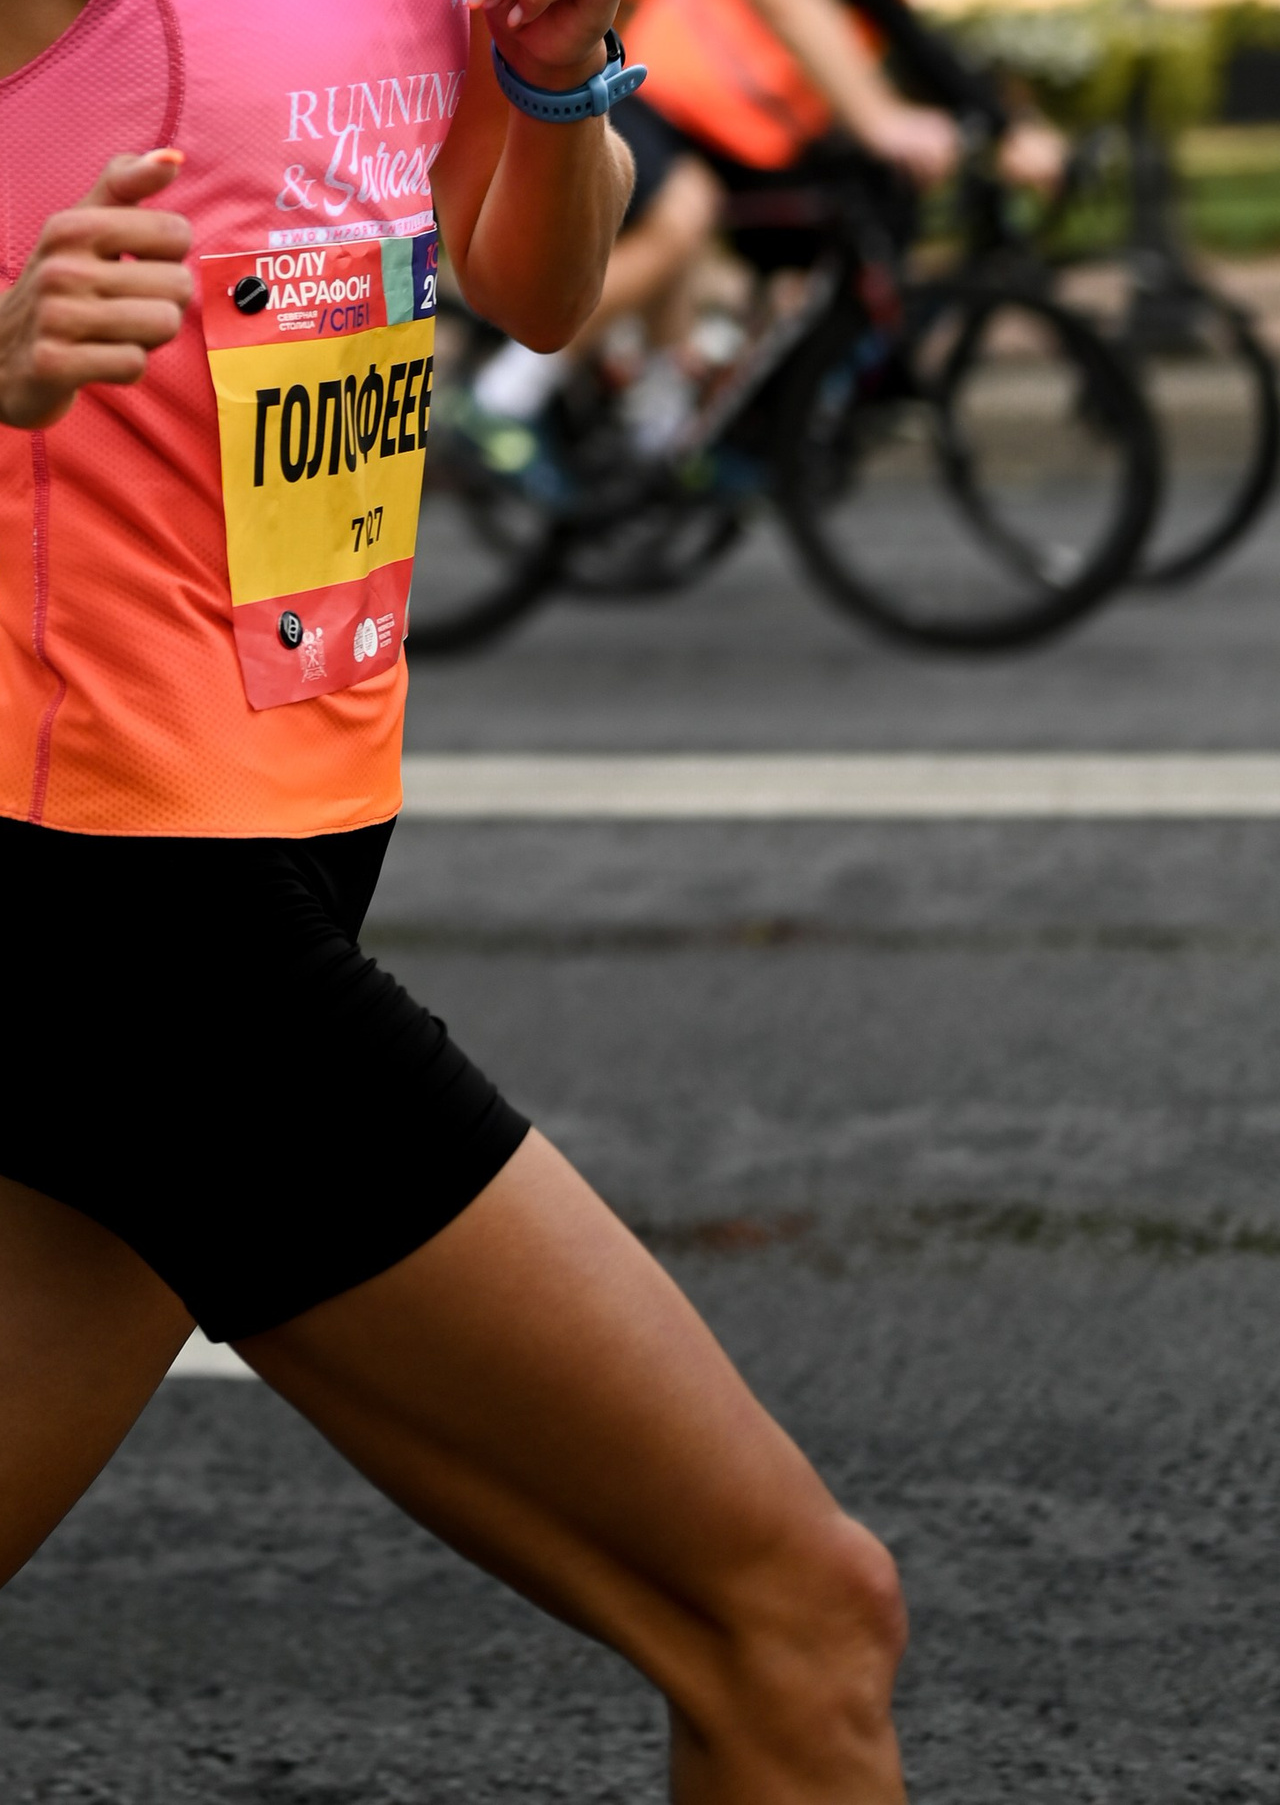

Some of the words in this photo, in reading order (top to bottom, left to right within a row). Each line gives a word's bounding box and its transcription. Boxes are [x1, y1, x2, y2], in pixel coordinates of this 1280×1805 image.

[275, 163, 319, 212] &
[322, 123, 444, 217] Sarcas
[280, 230, 317, 245] TWO
[326, 224, 397, 241] IMPORTAN
[255, 251, 327, 281] ПОЛУ
[276, 309, 319, 323] СЕВЕРНАЯ
[279, 320, 316, 332] СТОЛИЦА
